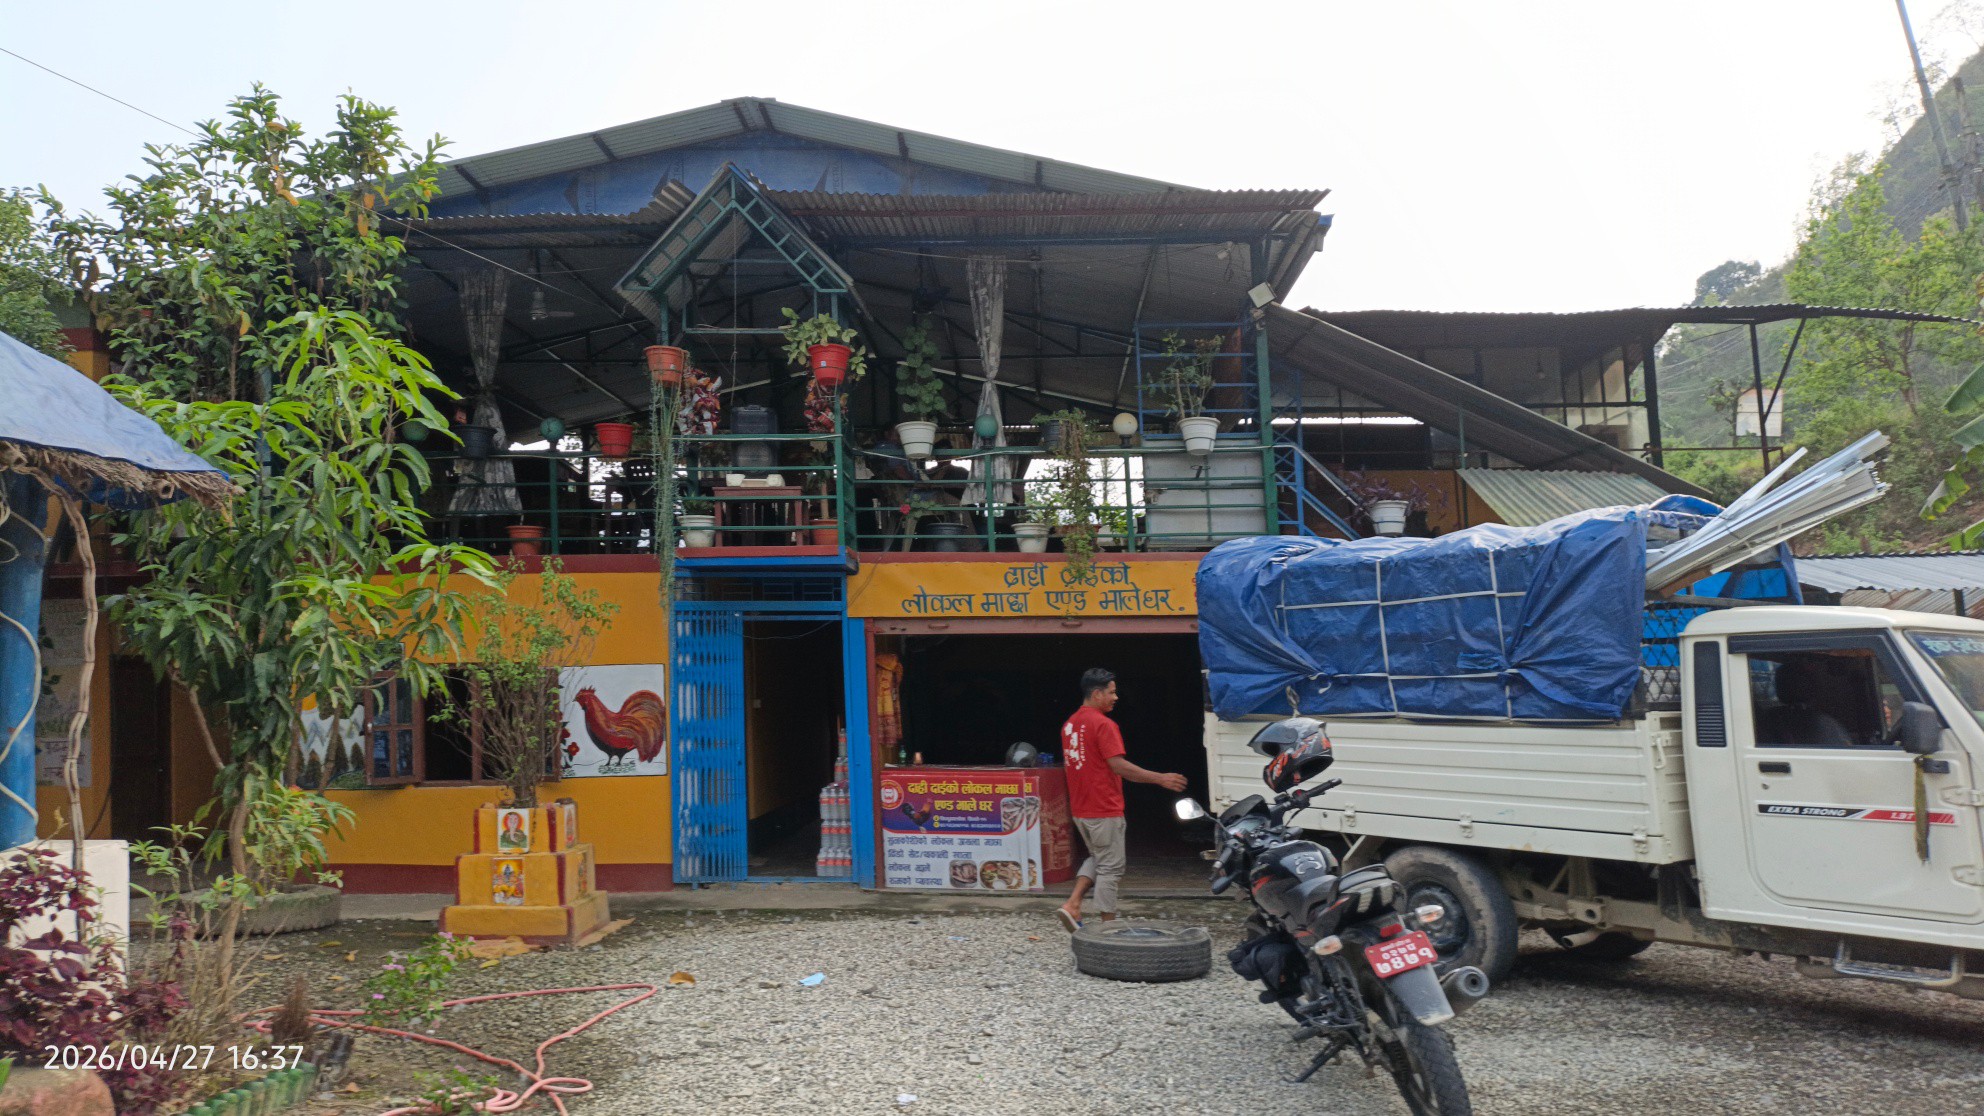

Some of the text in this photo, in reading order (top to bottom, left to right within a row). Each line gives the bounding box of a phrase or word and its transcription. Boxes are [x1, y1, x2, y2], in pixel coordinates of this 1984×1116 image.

[901, 585, 975, 614] लोकल
[1044, 590, 1090, 611] एण्ड
[961, 780, 992, 795] लोकल
[1767, 805, 1847, 817] EXTRA STRONG
